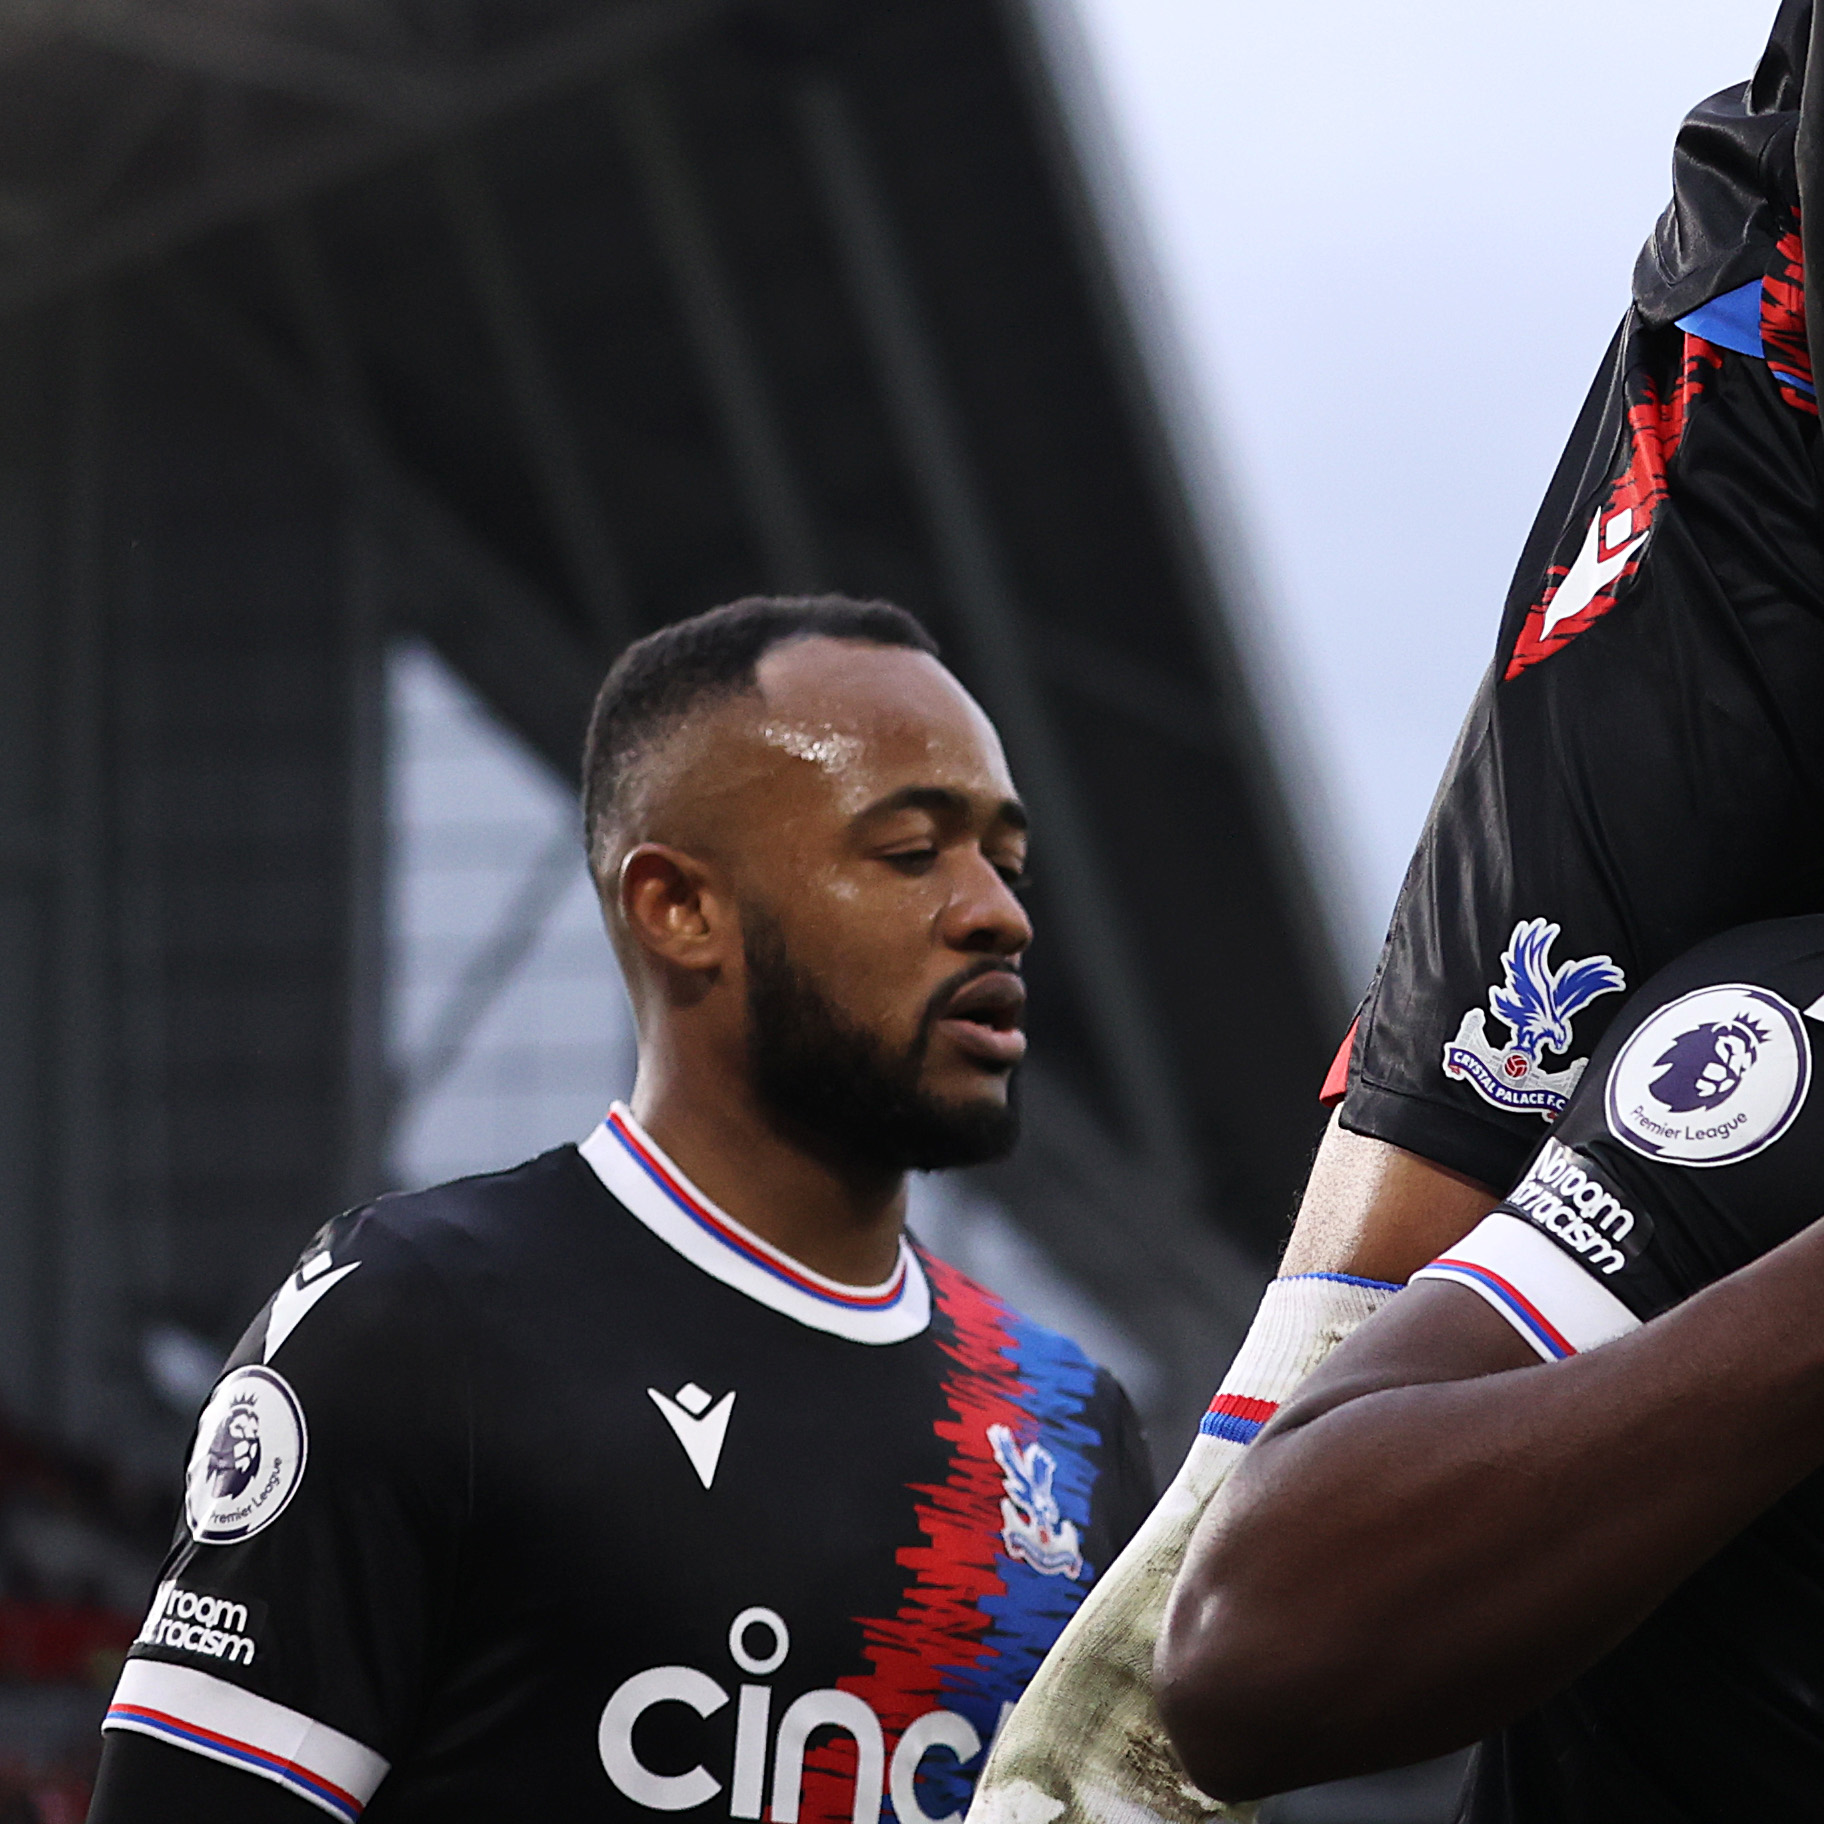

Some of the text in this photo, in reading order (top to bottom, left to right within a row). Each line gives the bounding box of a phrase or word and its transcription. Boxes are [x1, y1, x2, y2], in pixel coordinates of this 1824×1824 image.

[1453, 1051, 1497, 1094] CRYSTAL
[1495, 1087, 1545, 1105] PALACE
[1629, 1105, 1748, 1140] Premier League
[1550, 1164, 1635, 1243] room
[1522, 1189, 1626, 1275] racism
[251, 1456, 283, 1508] League
[166, 1588, 249, 1633] room
[155, 1618, 256, 1666] racism
[598, 1606, 1018, 1824] cinc
